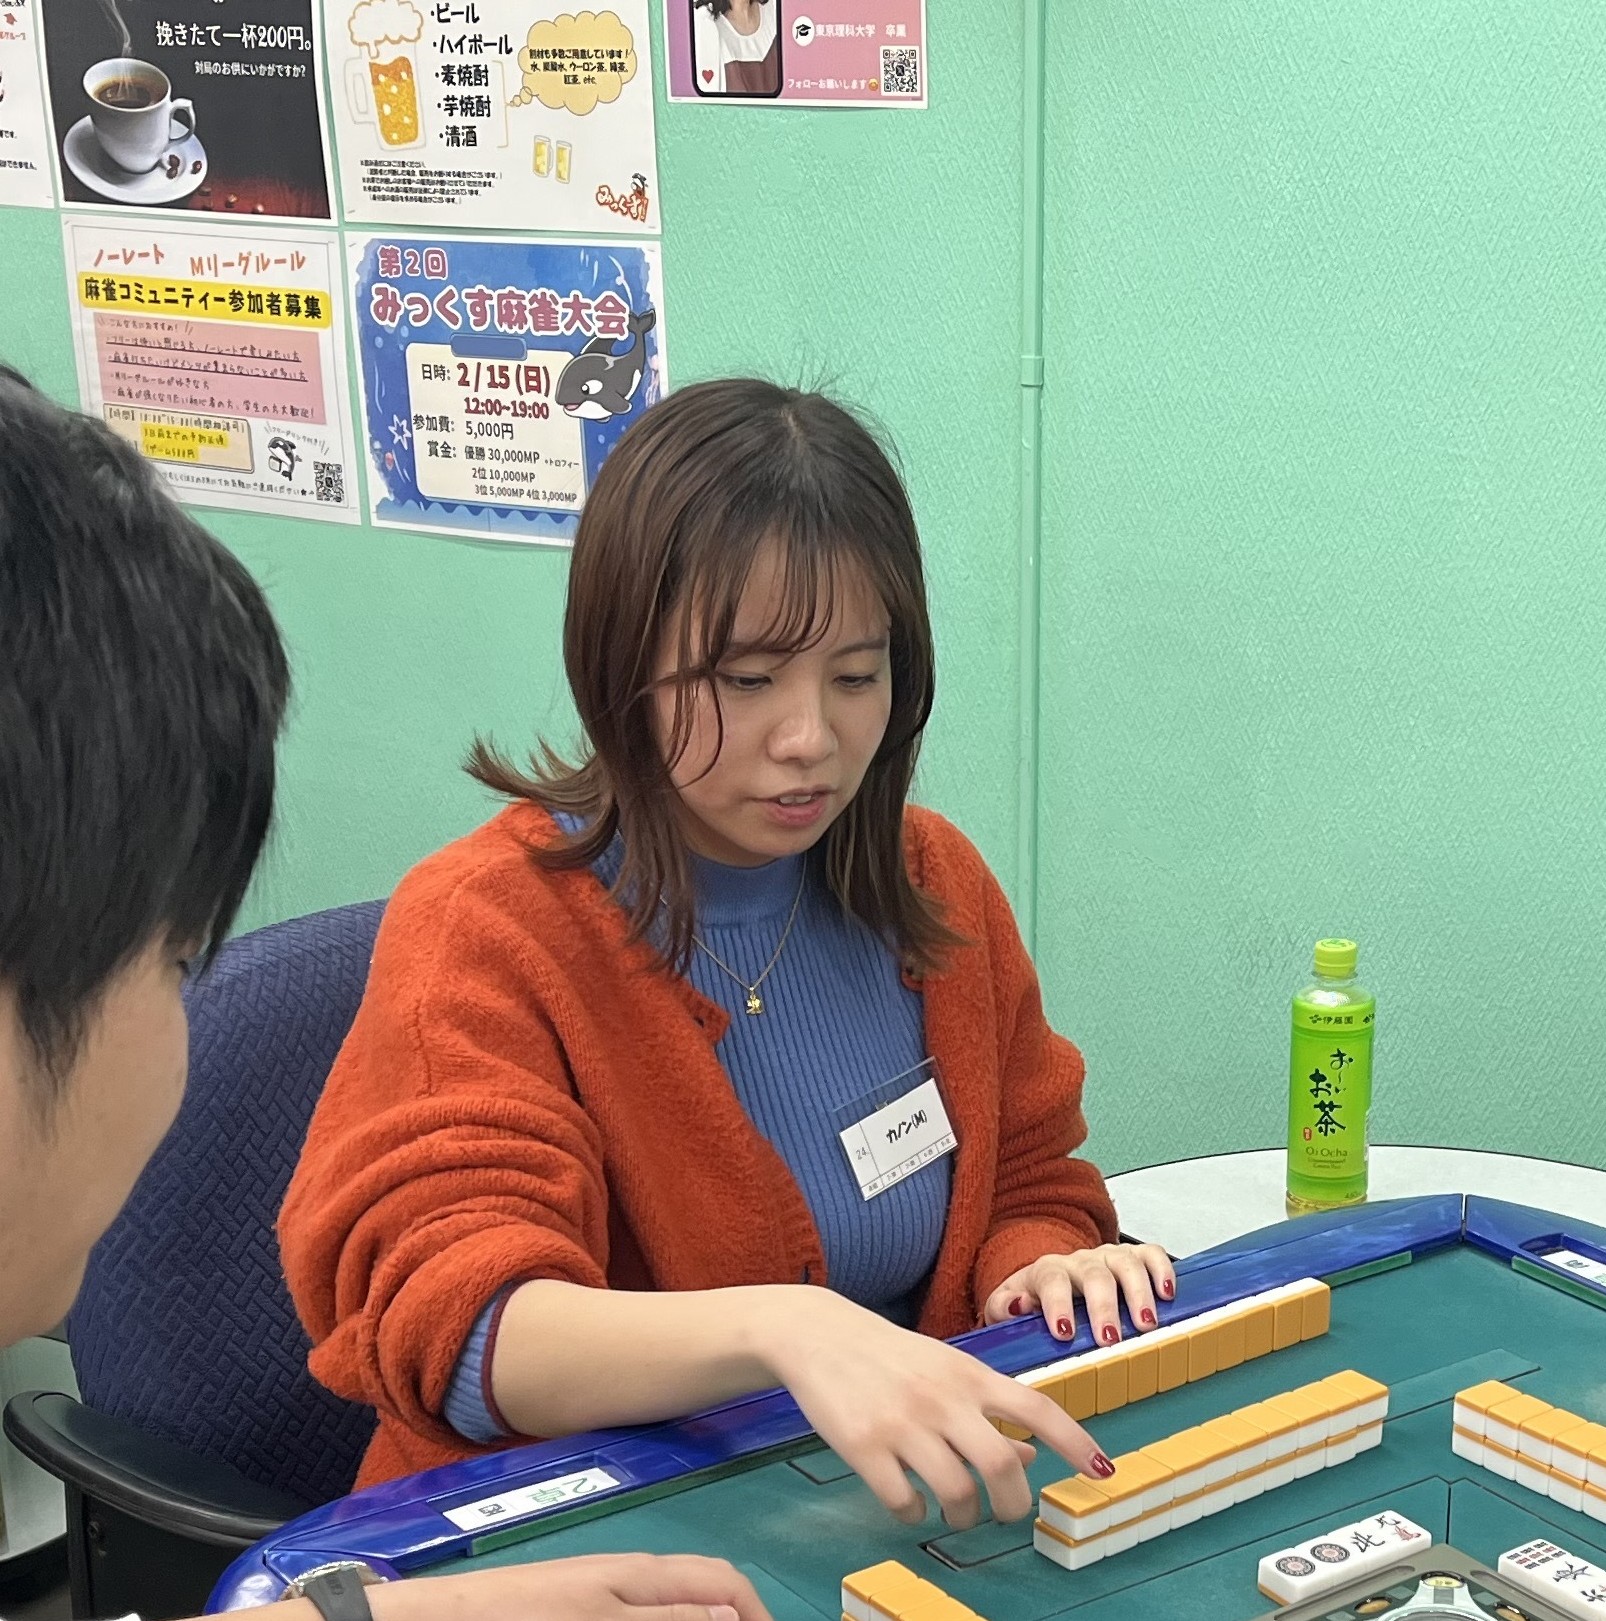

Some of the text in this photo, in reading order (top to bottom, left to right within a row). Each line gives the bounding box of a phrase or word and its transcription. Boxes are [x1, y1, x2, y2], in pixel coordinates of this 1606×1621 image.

[156, 20, 312, 51] 挽きたて一杯200円。
[815, 23, 906, 38] 東京理科大学 卒業
[788, 78, 866, 90] フォローお願いします
[93, 243, 307, 278] ノーレート Mリーグルール
[377, 246, 448, 279] 第2回
[84, 278, 322, 319] 麻雀コミュニティー参加者募集
[370, 284, 630, 339] みっくす麻雀大会
[465, 420, 514, 440] 5,000円
[465, 445, 485, 461] 優勝
[488, 449, 540, 464] 30,000MP
[472, 467, 536, 483] 2位 10,000MP
[475, 484, 578, 503] 3位 5,000MP 4位 3,000MP
[1309, 1068, 1347, 1137] お茶
[1320, 1148, 1348, 1157] Ocha
